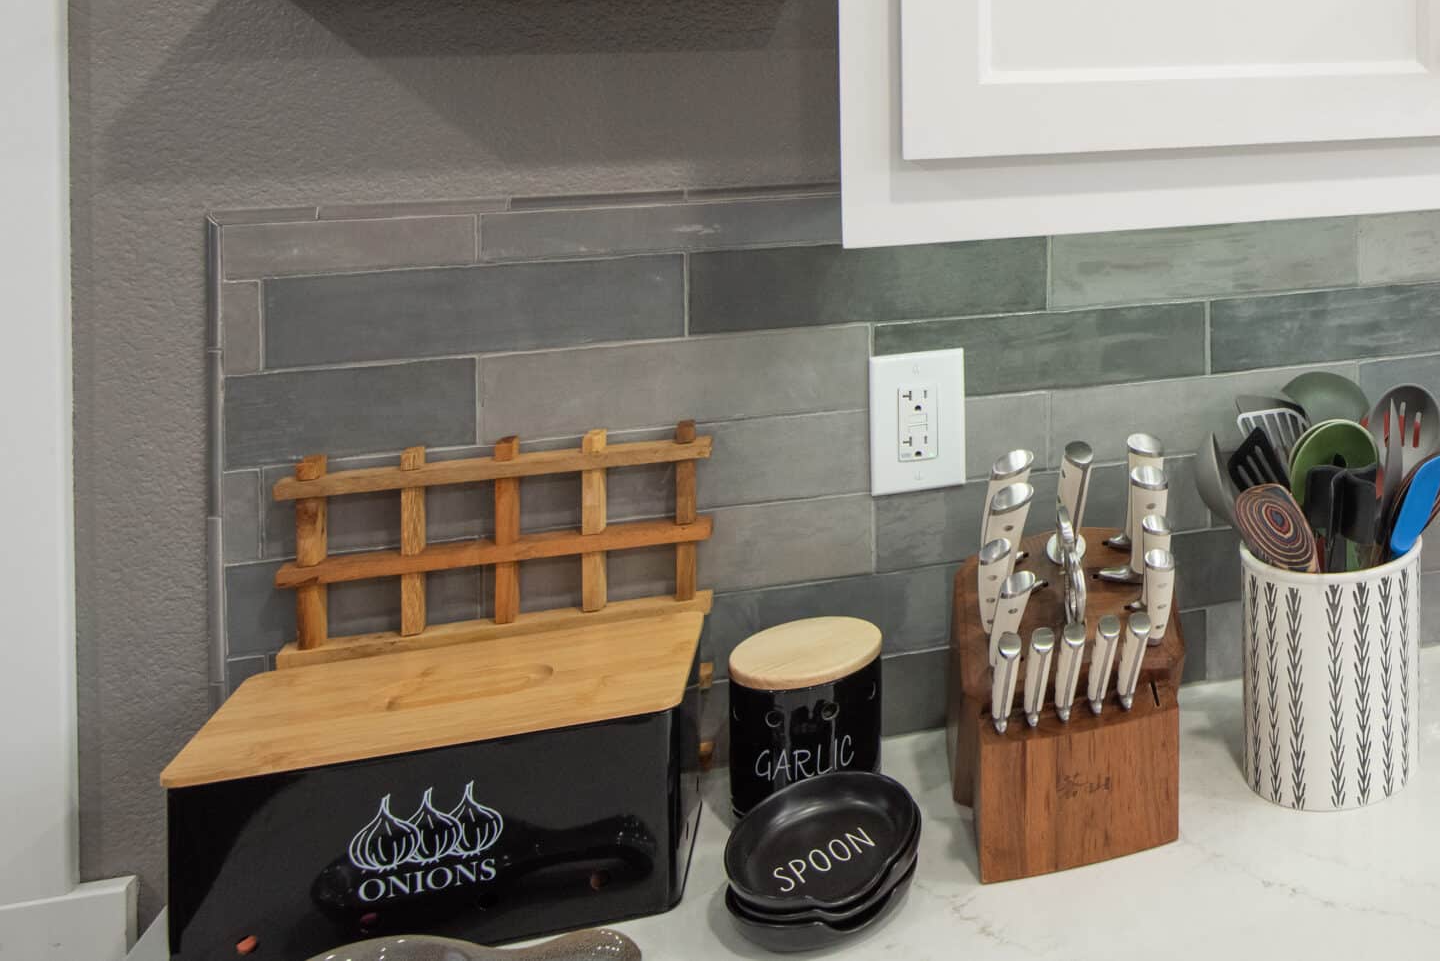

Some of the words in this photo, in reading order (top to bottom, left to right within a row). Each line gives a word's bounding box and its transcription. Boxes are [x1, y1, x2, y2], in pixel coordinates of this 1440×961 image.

[754, 734, 855, 781] GARLIC
[358, 858, 497, 902] ONIONS
[773, 827, 876, 892] SPOON
